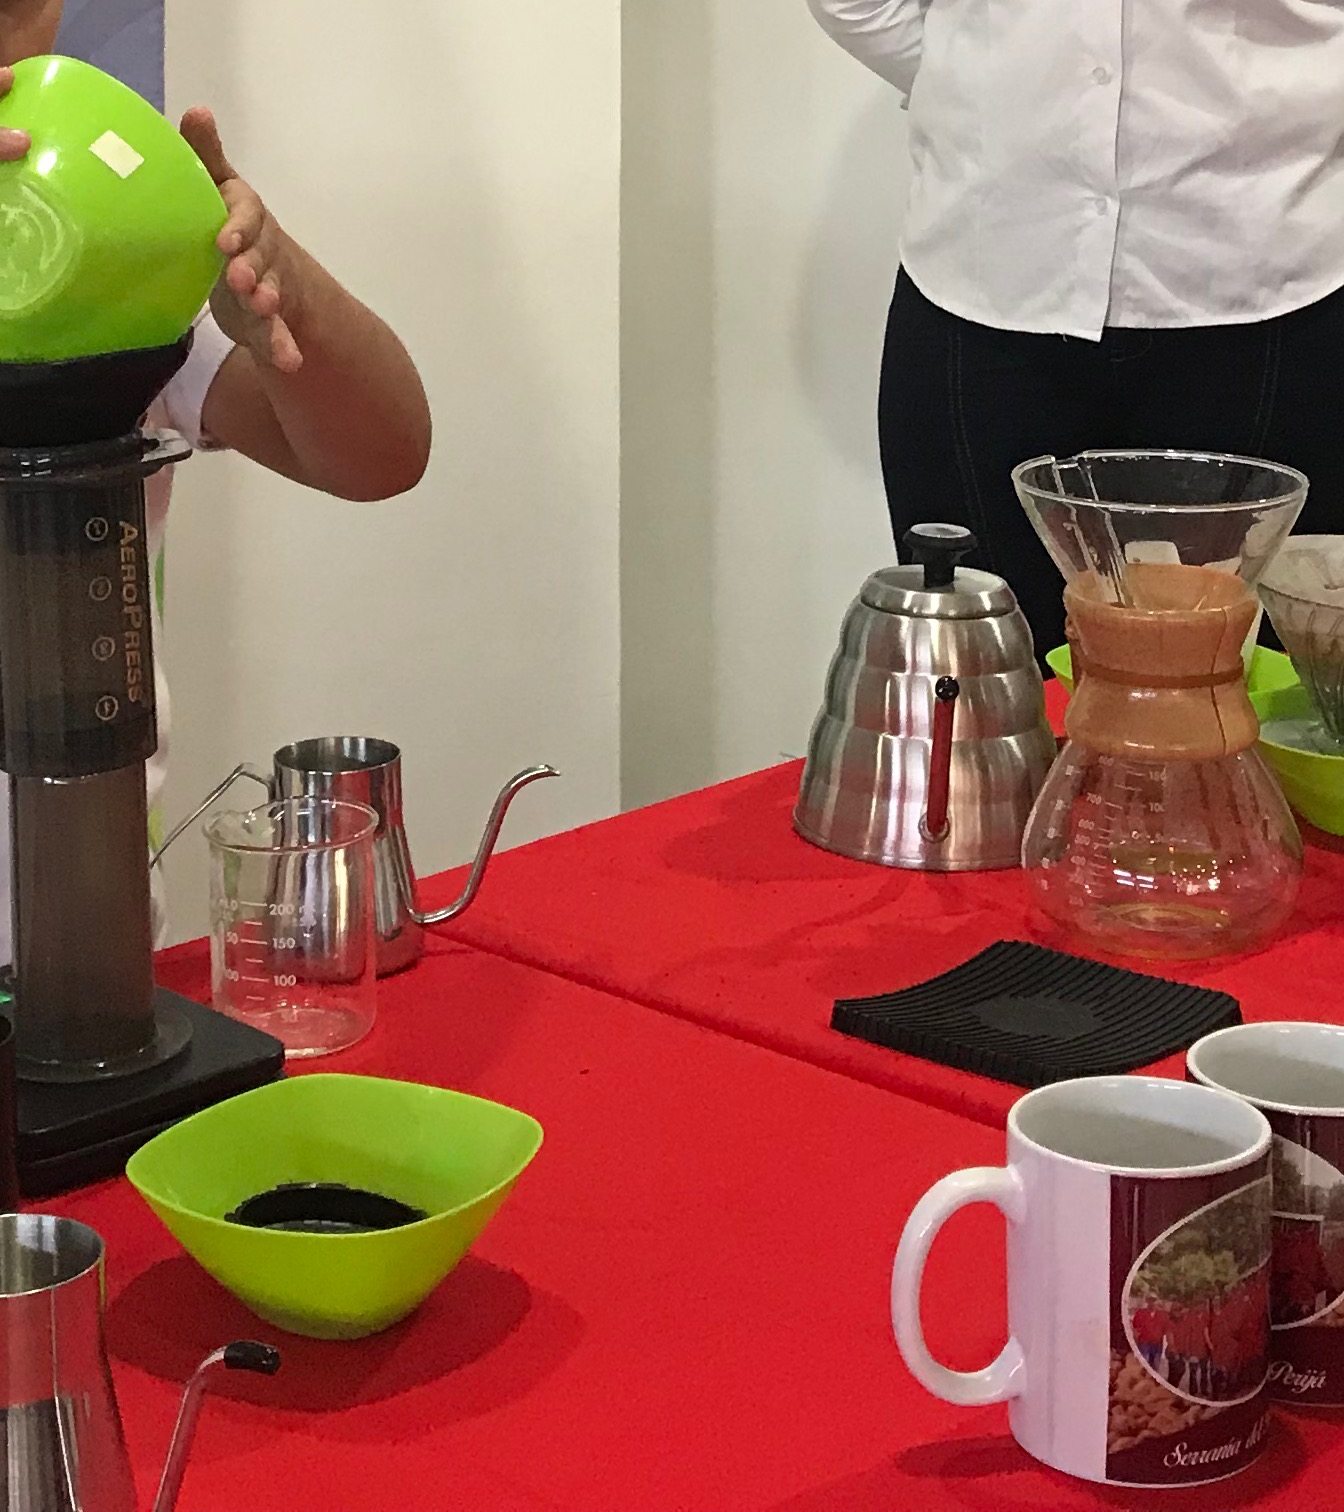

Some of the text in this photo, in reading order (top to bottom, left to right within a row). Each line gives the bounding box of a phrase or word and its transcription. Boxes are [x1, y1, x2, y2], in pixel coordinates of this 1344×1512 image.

[269, 903, 294, 915] 200
[272, 937, 295, 949] 150
[273, 974, 296, 986] 100
